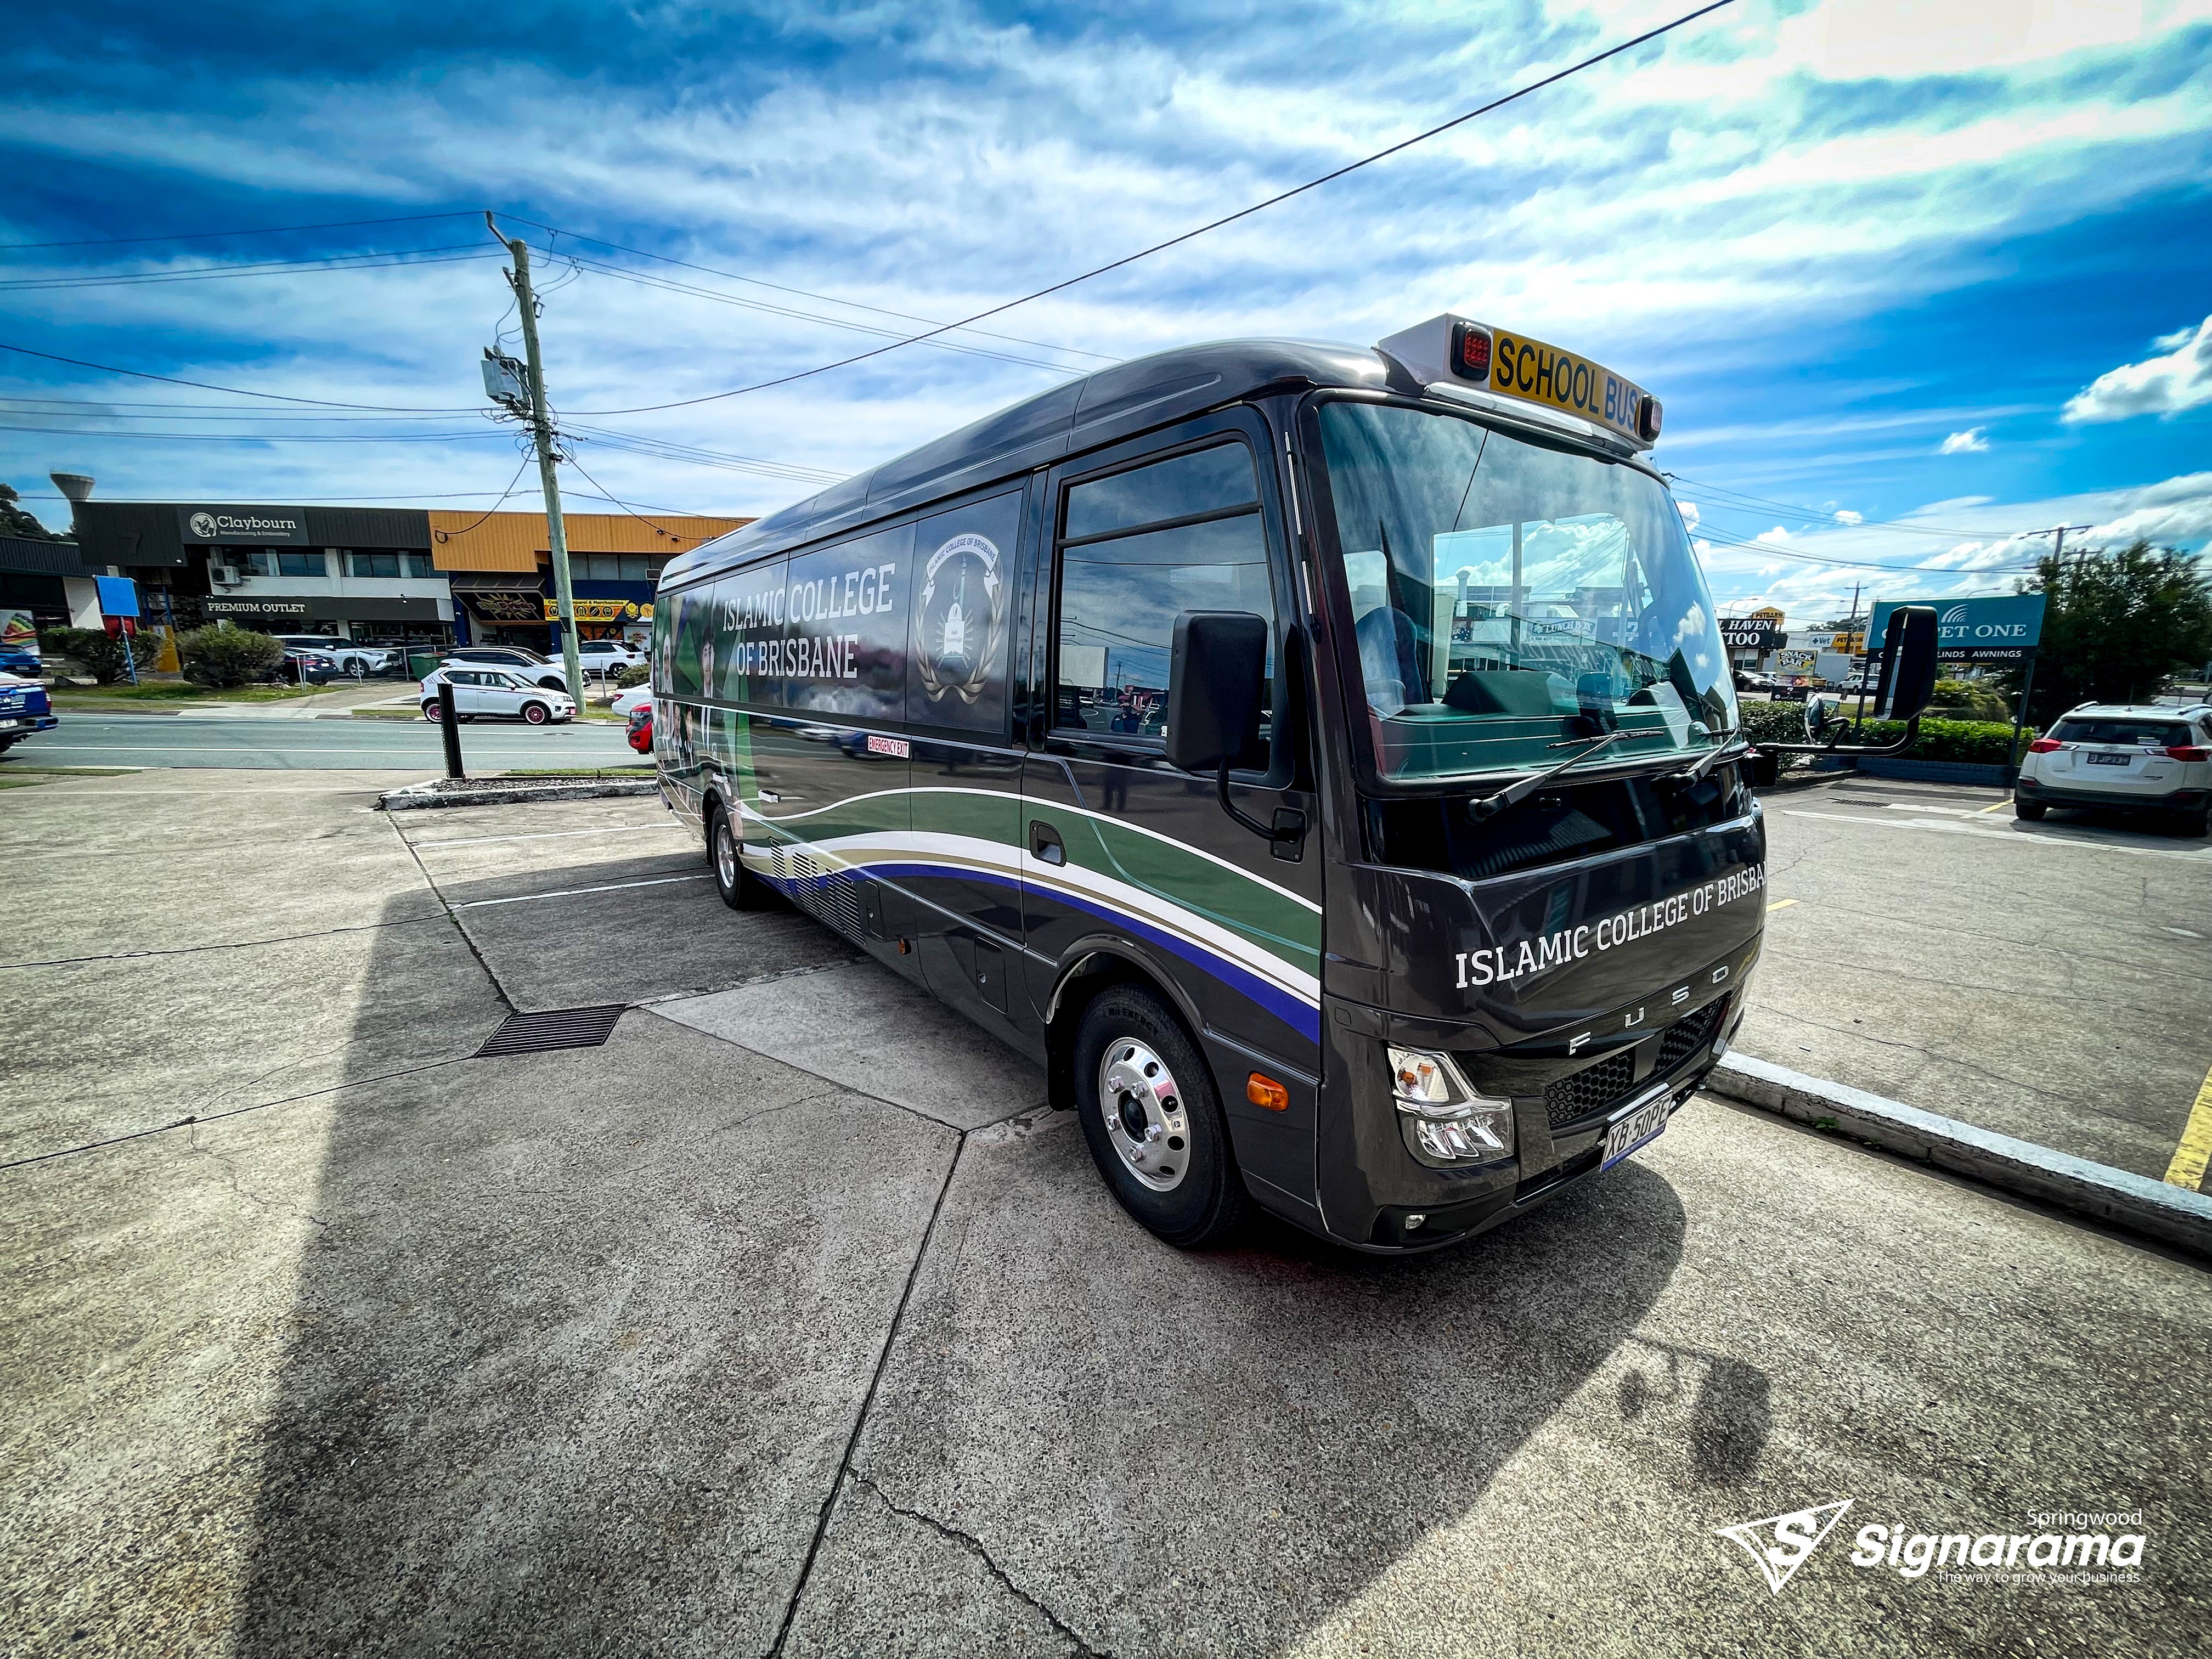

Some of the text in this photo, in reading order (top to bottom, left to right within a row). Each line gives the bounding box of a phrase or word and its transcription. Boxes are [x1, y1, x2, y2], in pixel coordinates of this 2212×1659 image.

[1497, 338, 1638, 431] SCHOOL BUS
[217, 516, 297, 529] Claybourn
[928, 550, 945, 574] ISLAMIC
[946, 538, 967, 553] COLLEGE
[974, 539, 996, 562] BRISBANE
[723, 563, 896, 631] ISLAMIC COLLEGE
[207, 602, 305, 612] PREMIUM OUTLET
[1545, 620, 1593, 633] LUNCH BOX
[1728, 620, 1773, 630] HAVEN
[1975, 624, 2026, 637] ONE
[736, 634, 859, 678] OF BRISBANE
[1780, 651, 1812, 661] SNACK
[1782, 658, 1803, 667] BAR
[870, 738, 908, 756] EMERGENCY EXIT
[1455, 925, 1589, 989] ISLAMIC
[1597, 893, 1689, 951] COLLEGE
[1692, 883, 1714, 915] OF
[1568, 965, 1729, 1056] FUSO
